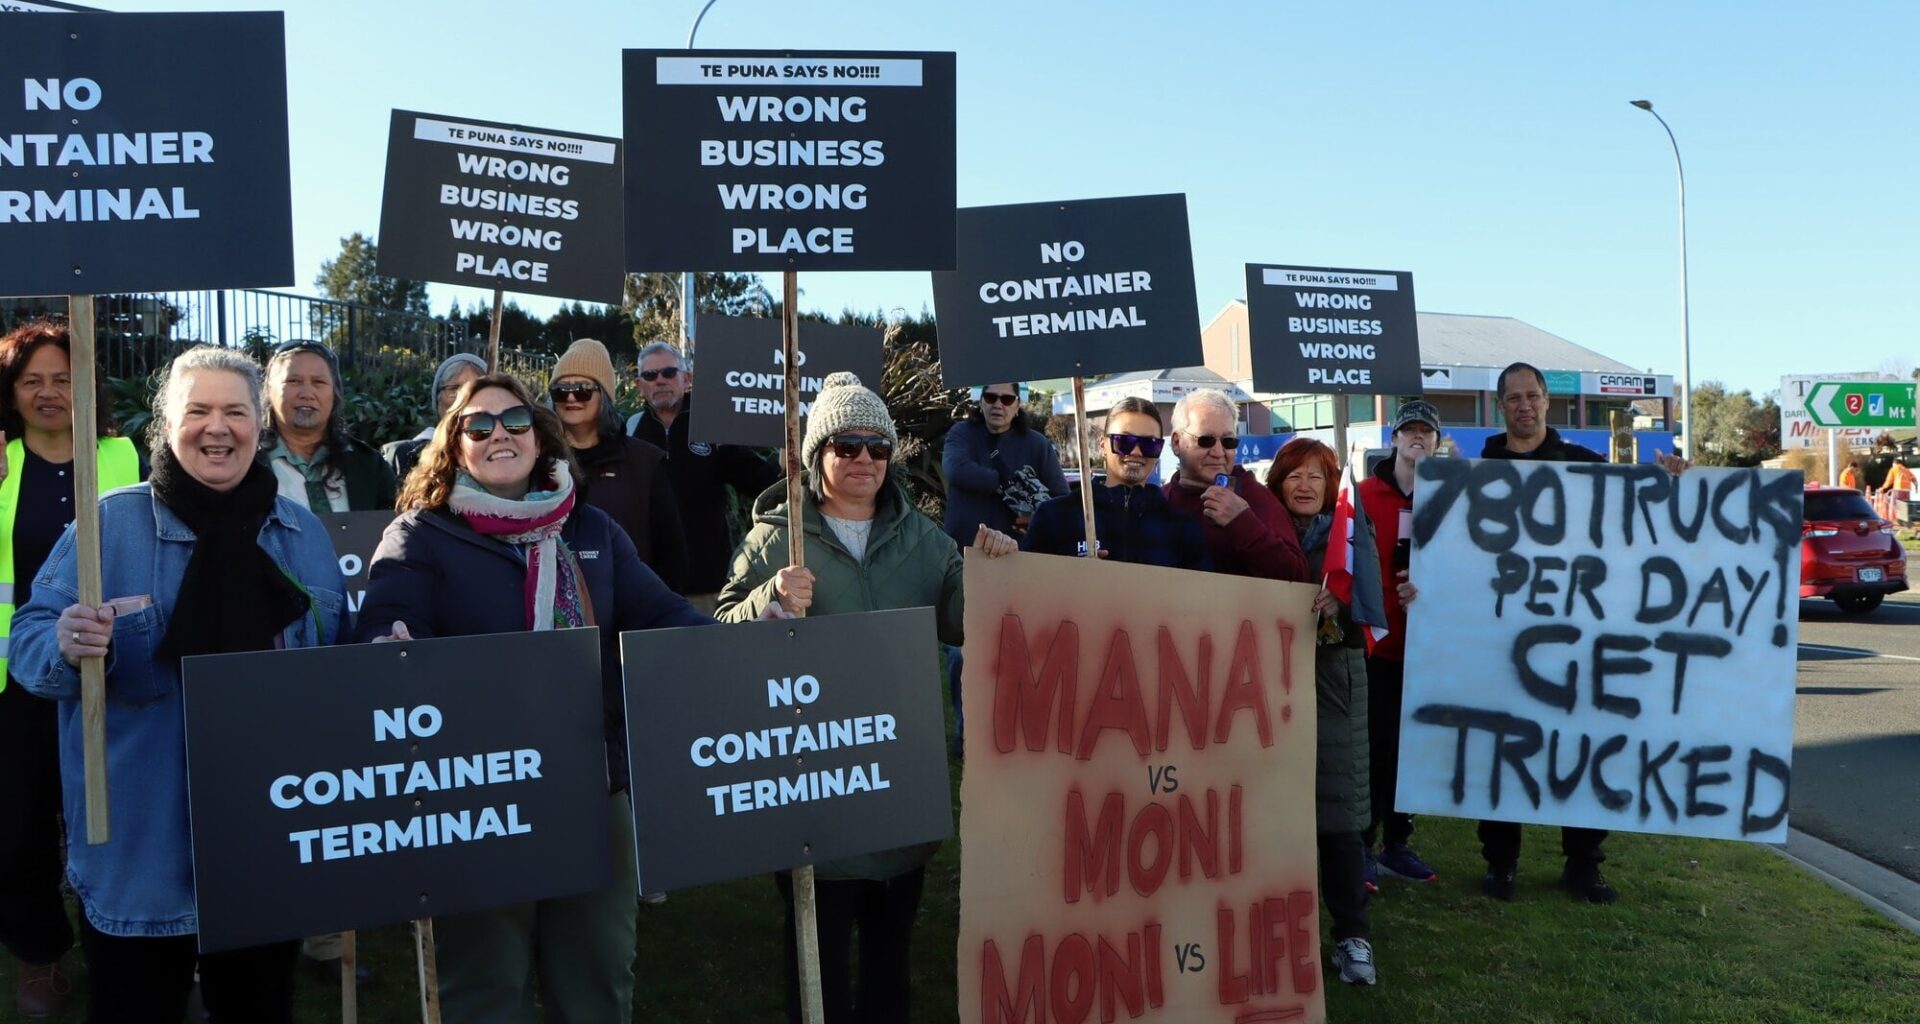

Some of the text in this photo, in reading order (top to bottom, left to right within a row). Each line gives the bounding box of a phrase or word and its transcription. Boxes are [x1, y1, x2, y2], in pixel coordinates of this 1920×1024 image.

[701, 64, 880, 79] TE PUNA SAYS NO!!!!
[25, 78, 102, 111] NO
[717, 96, 867, 123] WRONG
[448, 128, 583, 154] TE PUNA SAYS NO!!!!
[701, 140, 885, 166] BUSINESS
[457, 153, 570, 186] WRONG
[0, 187, 200, 223] RMINAL
[440, 184, 579, 220] BUSINESS
[717, 184, 867, 210] WRONG
[450, 218, 562, 251] WRONG
[732, 227, 854, 253] PLACE
[456, 253, 549, 283] PLACE
[1040, 240, 1085, 264] NO
[979, 271, 1152, 304] CONTAINER
[1286, 273, 1297, 282] TE
[1300, 275, 1325, 283] PUNA
[1327, 275, 1350, 284] SAYS
[1295, 292, 1372, 310] WRONG
[992, 306, 1146, 338] TERMINAL
[1288, 317, 1383, 336] BUSINESS
[1299, 343, 1376, 360] WRONG
[725, 371, 825, 393] CONTIN
[1308, 368, 1372, 385] PLACE
[1600, 375, 1642, 386] CANAM
[731, 396, 812, 416] TERMN
[1850, 397, 1858, 410] 2
[1889, 406, 1906, 419] Mt
[1412, 459, 1566, 554] 780
[1491, 554, 1789, 648] PER DAY!
[993, 613, 1294, 760] MANA!
[1511, 624, 1732, 718] GET
[767, 674, 820, 708] NO
[373, 704, 443, 742] NO
[690, 713, 897, 767] CONTAINER
[269, 748, 543, 809] CONTAINER
[1148, 765, 1179, 795] VS
[1411, 703, 1792, 836] TRUCKED
[706, 762, 890, 816] TERMINAL
[289, 803, 532, 864] TERMINAL
[1064, 784, 1243, 905] MONI
[981, 890, 1317, 1024] MONI VS LIFE
